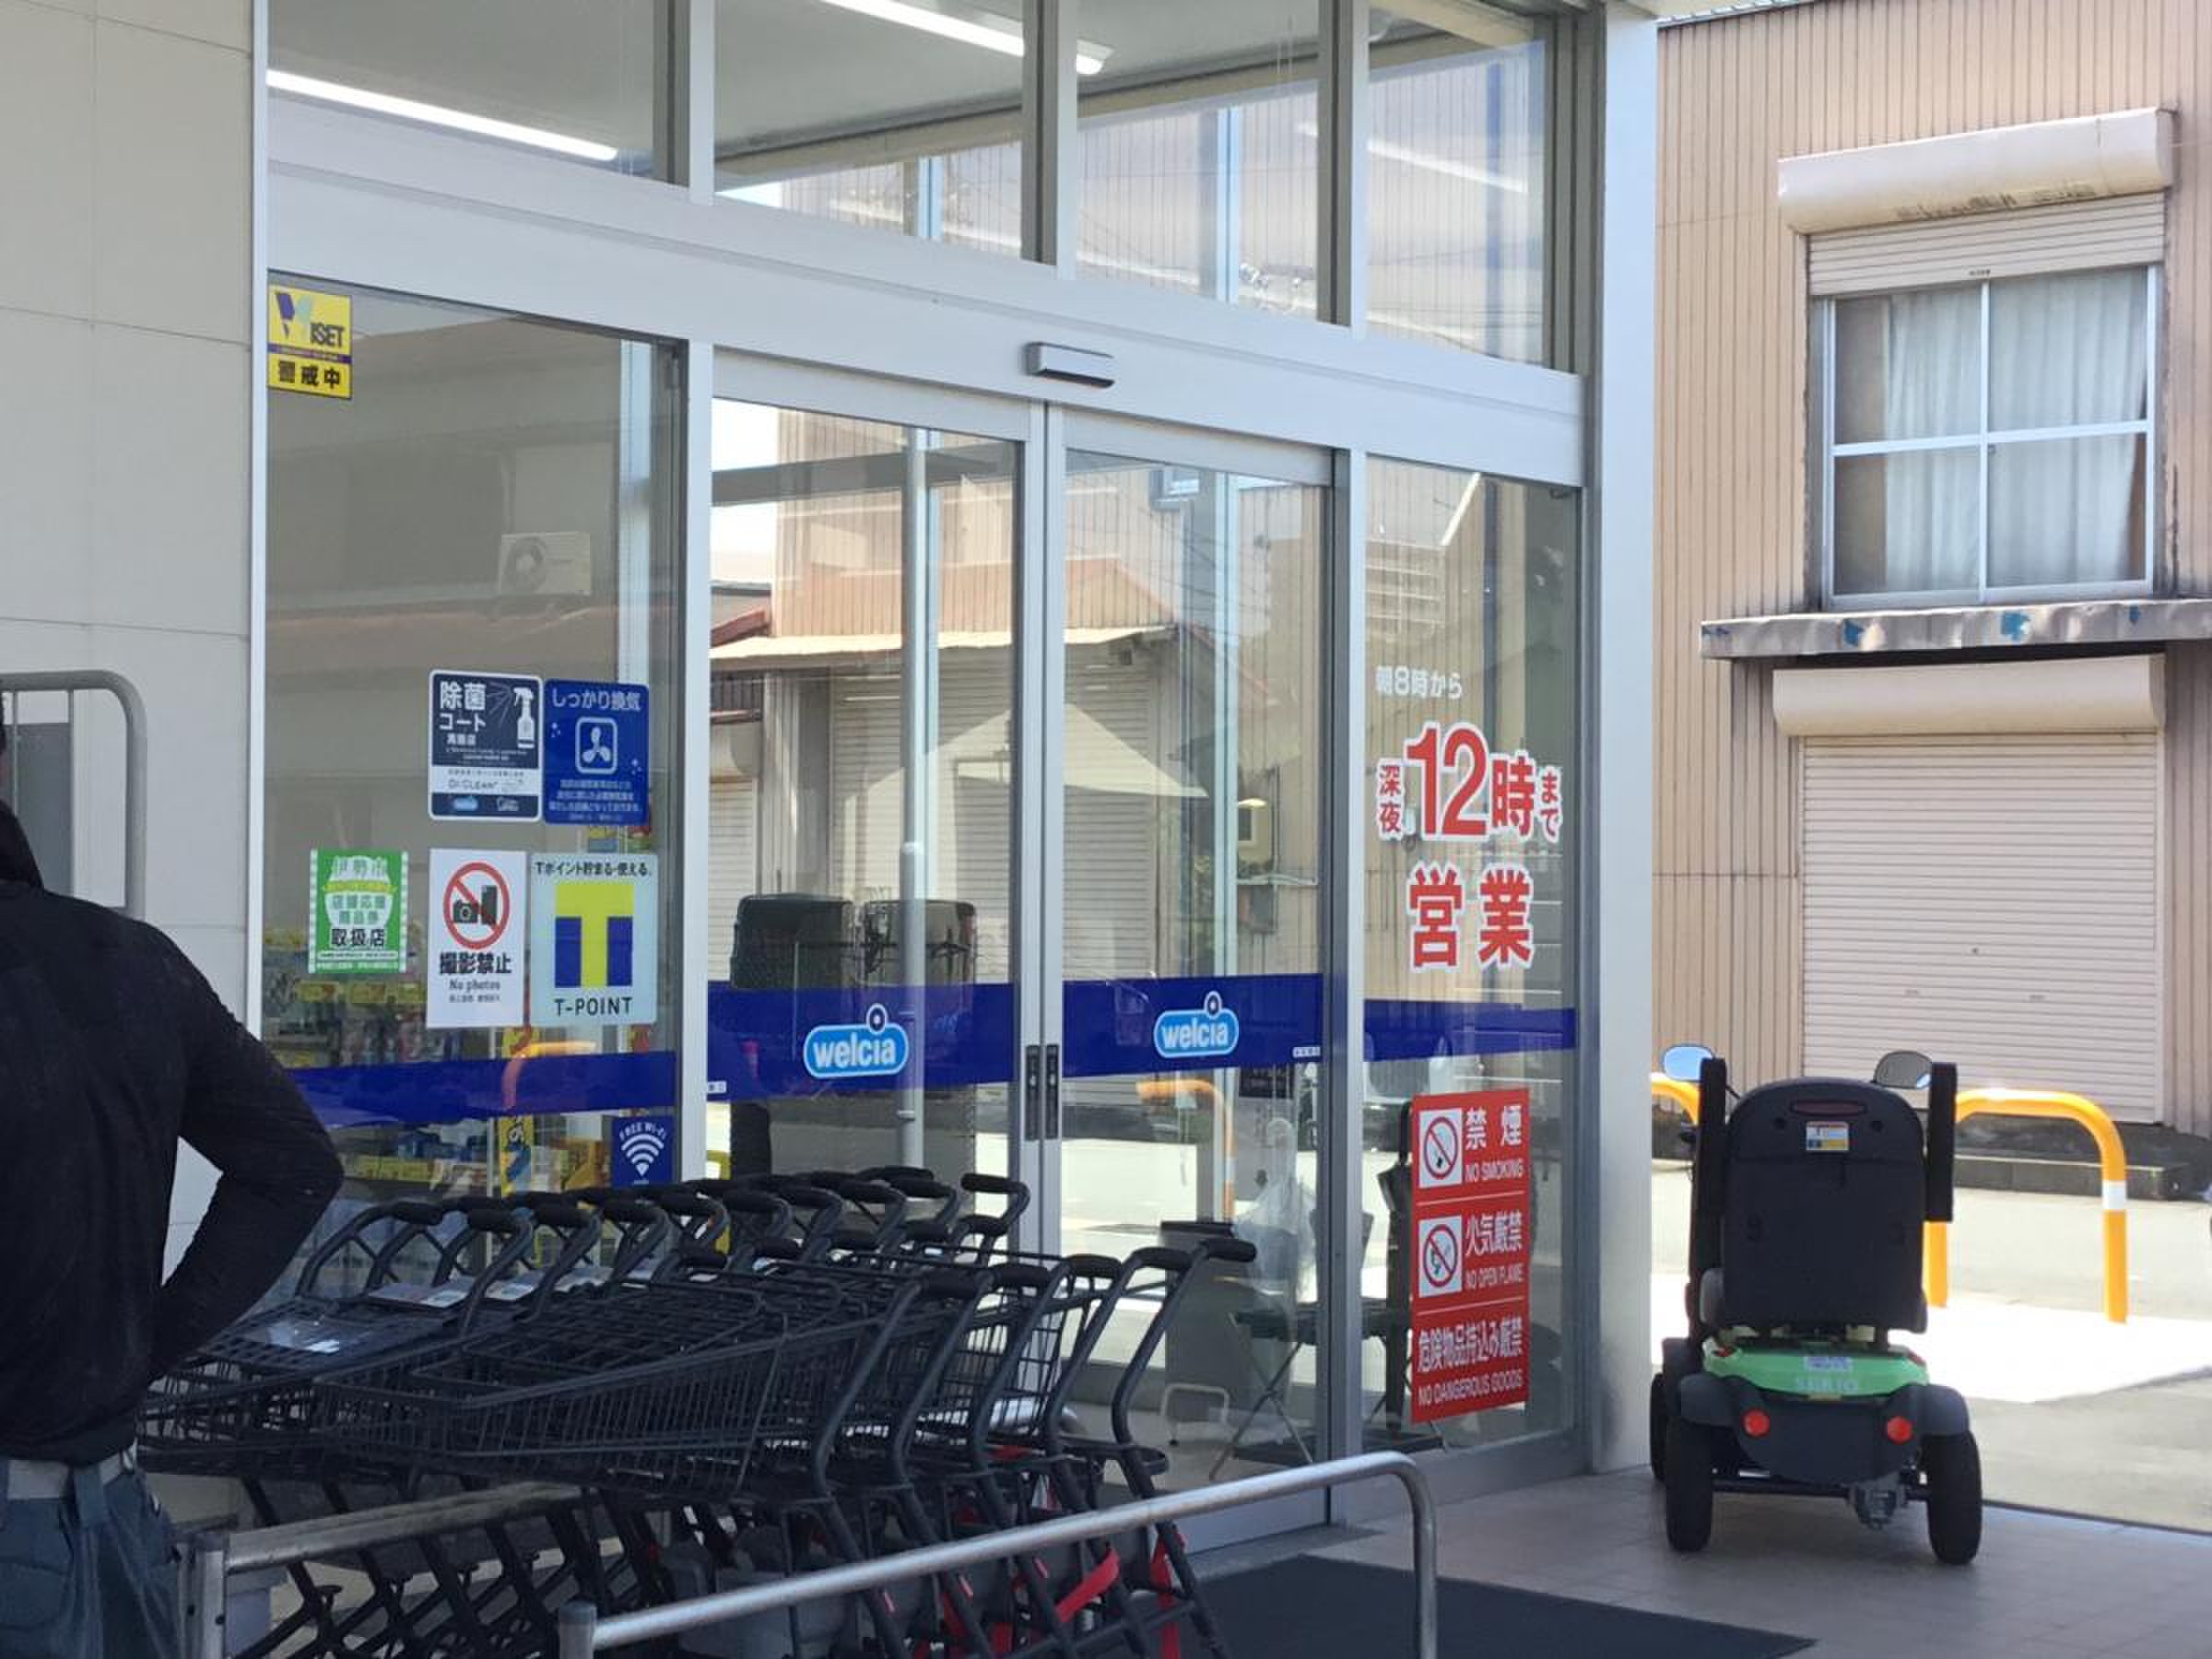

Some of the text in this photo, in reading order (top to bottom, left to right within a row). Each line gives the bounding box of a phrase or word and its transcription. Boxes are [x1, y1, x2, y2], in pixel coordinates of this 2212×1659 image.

[440, 681, 487, 710] 除菌
[440, 712, 487, 732] コート
[1378, 761, 1402, 836] 深夜
[1539, 769, 1562, 841] まで
[1408, 867, 1533, 969] 営業
[331, 928, 385, 947] 取扱店
[440, 952, 512, 975] 撮影禁止
[555, 996, 632, 1016] T-POINT
[1465, 1105, 1522, 1150] 禁煙
[1465, 1159, 1524, 1182] NO SMOKING
[1465, 1210, 1522, 1256] 火気厳禁
[1418, 1384, 1431, 1406] NO
